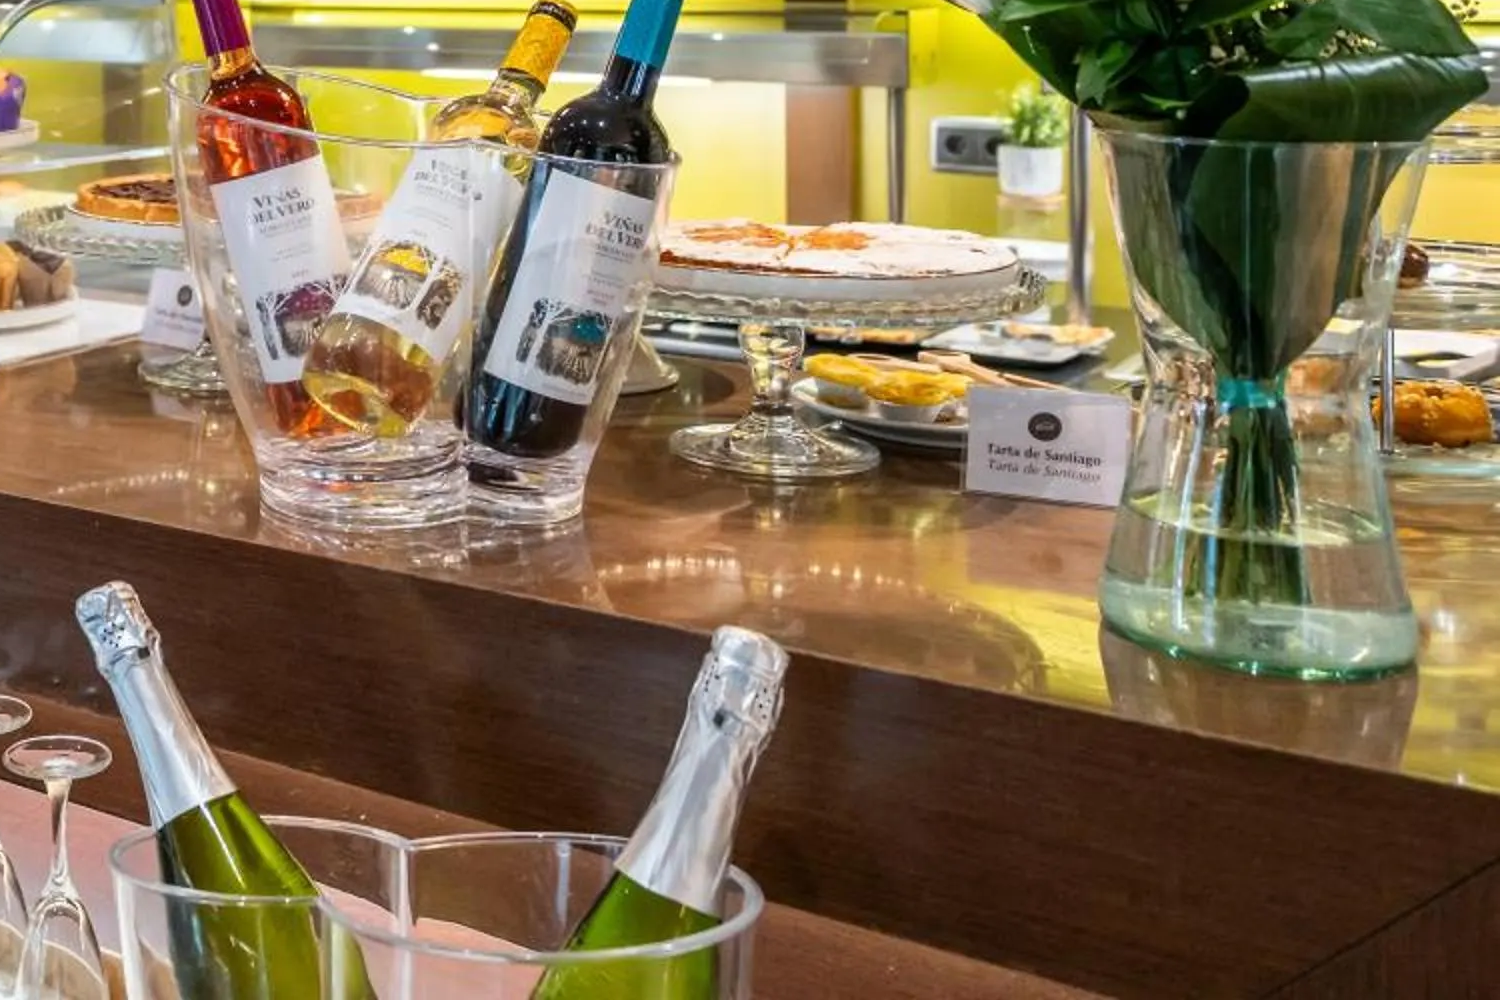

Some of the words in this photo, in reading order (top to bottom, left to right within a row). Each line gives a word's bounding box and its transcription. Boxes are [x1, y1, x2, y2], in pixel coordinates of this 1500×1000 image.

[987, 442, 1021, 458] Tarta
[1023, 446, 1041, 461] de
[1044, 450, 1102, 468] Santiago
[988, 459, 1020, 473] Tarta
[1022, 463, 1040, 476] de
